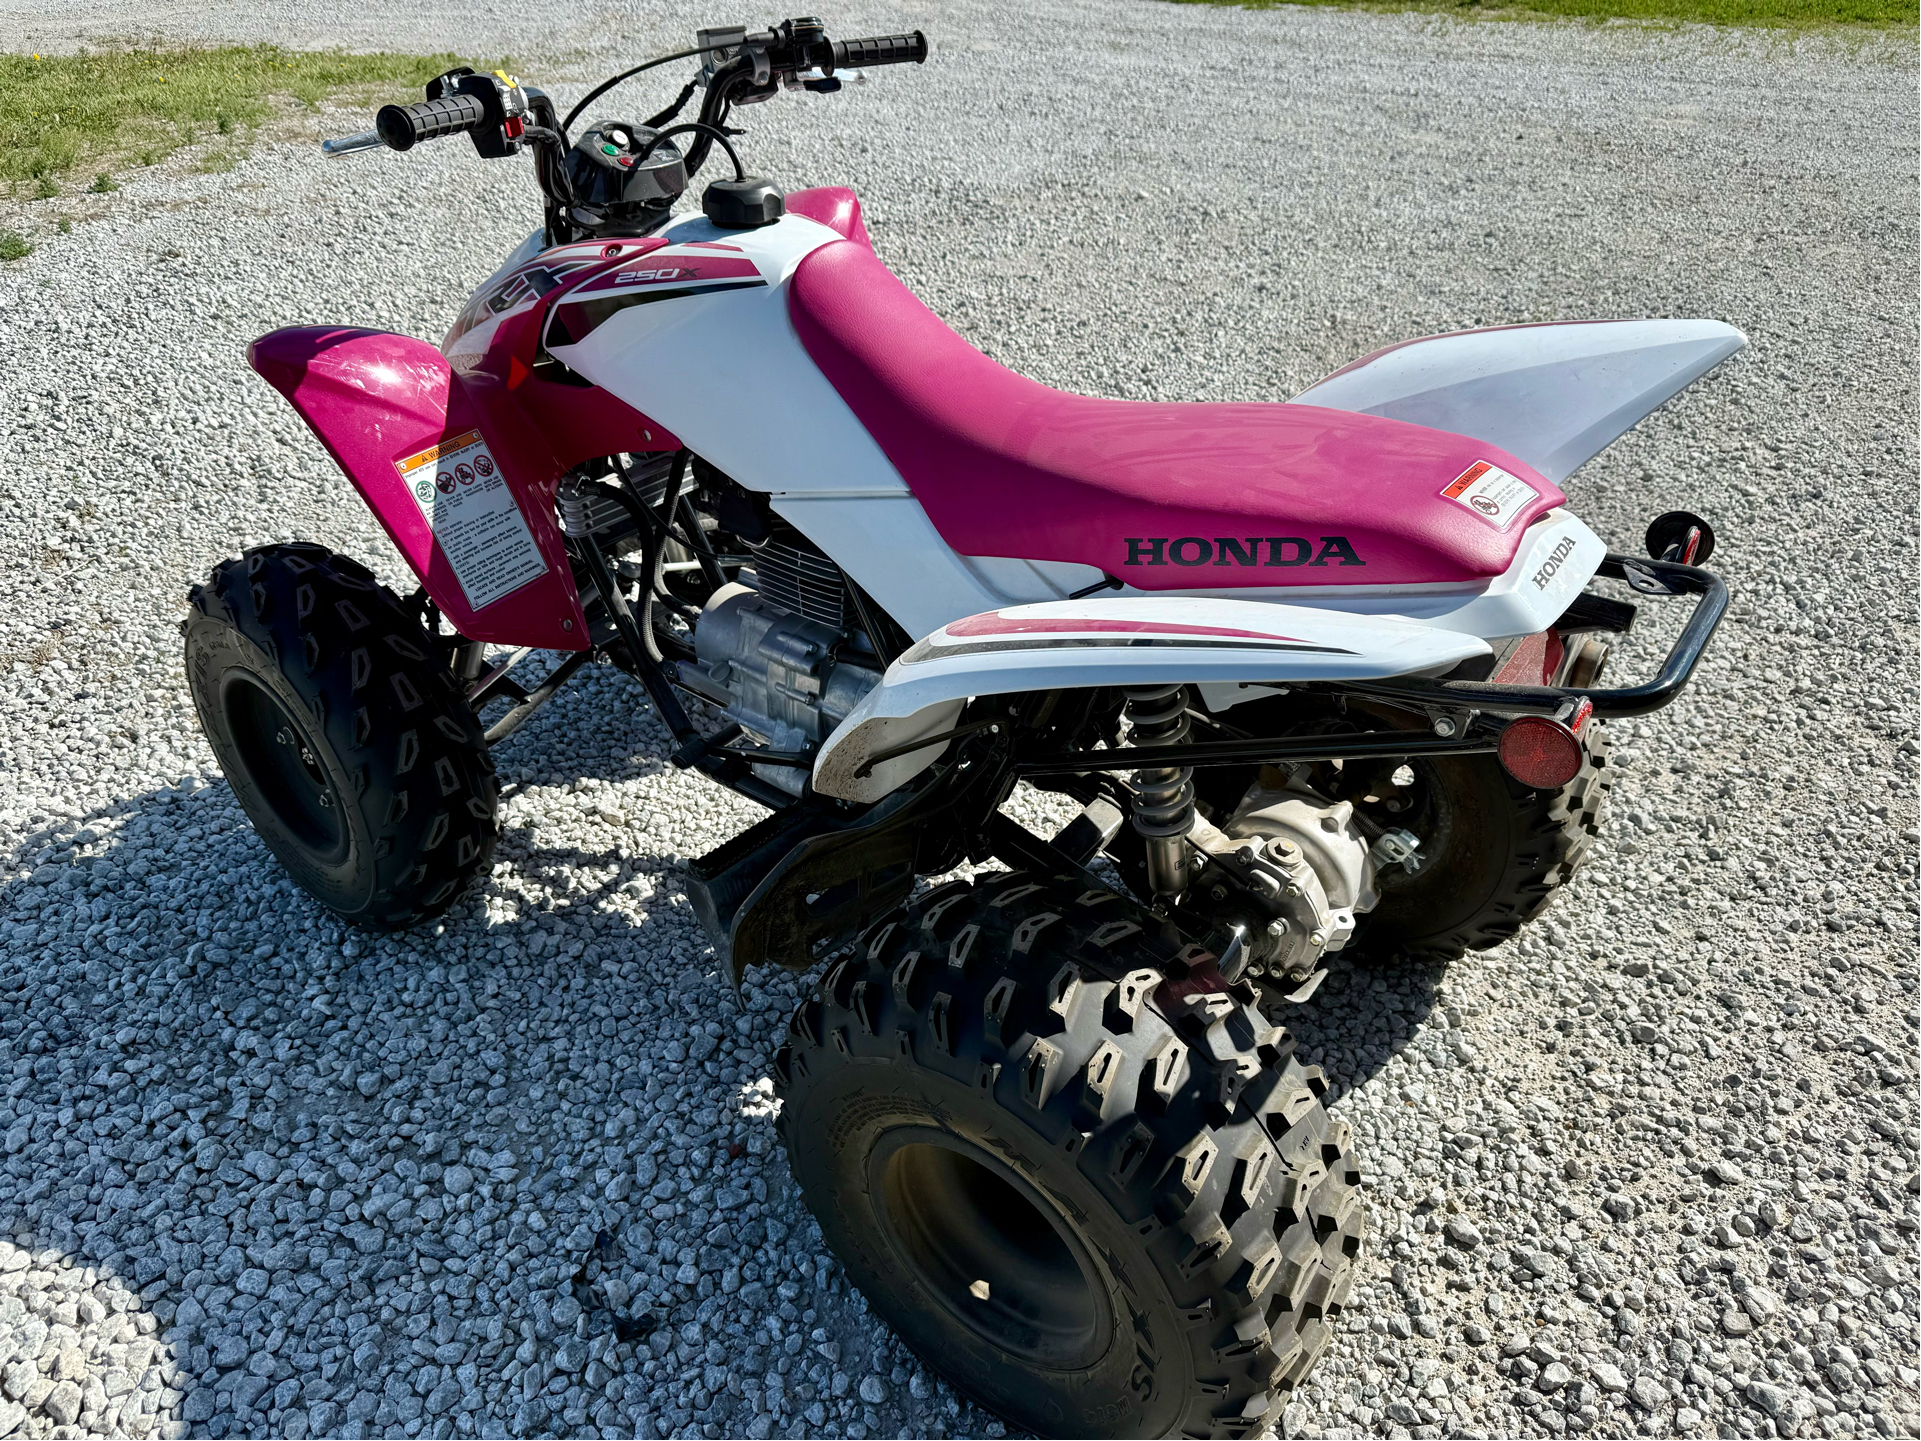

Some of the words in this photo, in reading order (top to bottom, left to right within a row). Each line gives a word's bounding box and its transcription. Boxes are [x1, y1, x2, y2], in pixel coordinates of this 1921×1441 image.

[615, 267, 701, 284] 250X
[428, 441, 461, 459] WARNING
[1123, 536, 1367, 567] HONDA
[1531, 535, 1577, 590] HONDA
